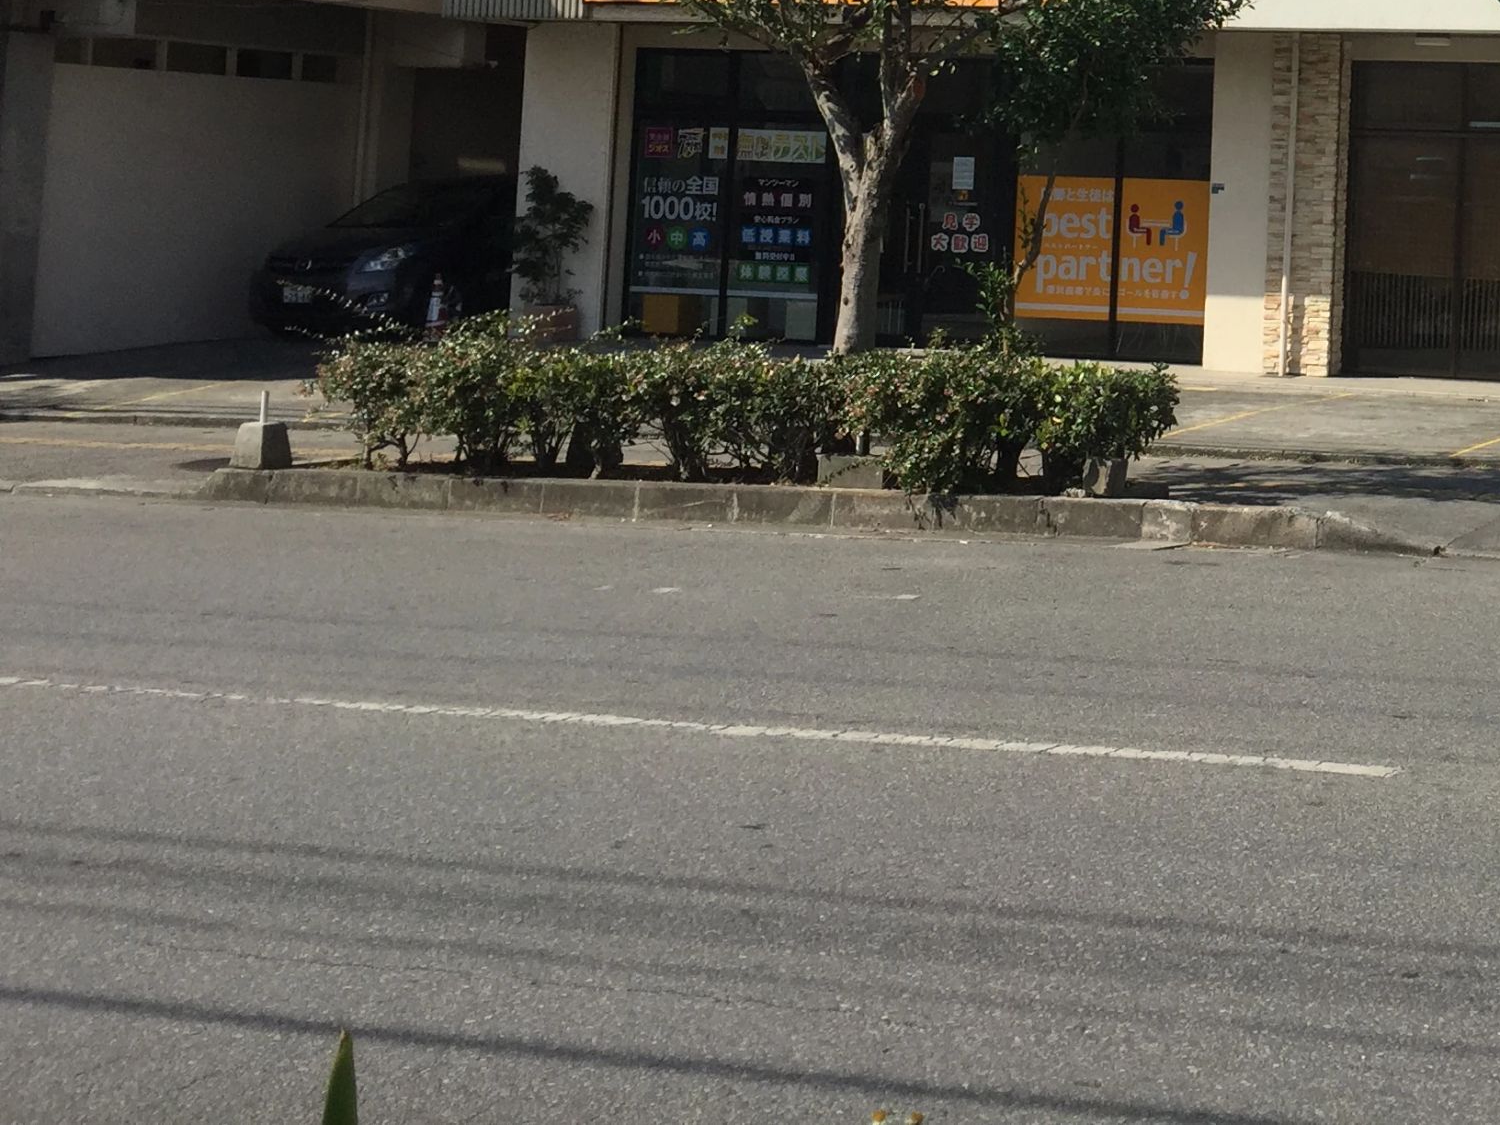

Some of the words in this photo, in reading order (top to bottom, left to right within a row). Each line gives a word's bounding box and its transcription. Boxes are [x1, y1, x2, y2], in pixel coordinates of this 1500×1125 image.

[643, 176, 720, 195] 信頼の全国
[641, 195, 718, 221] 1000校!
[942, 212, 981, 232] 見学
[647, 229, 661, 244] 小
[670, 230, 683, 245] 中
